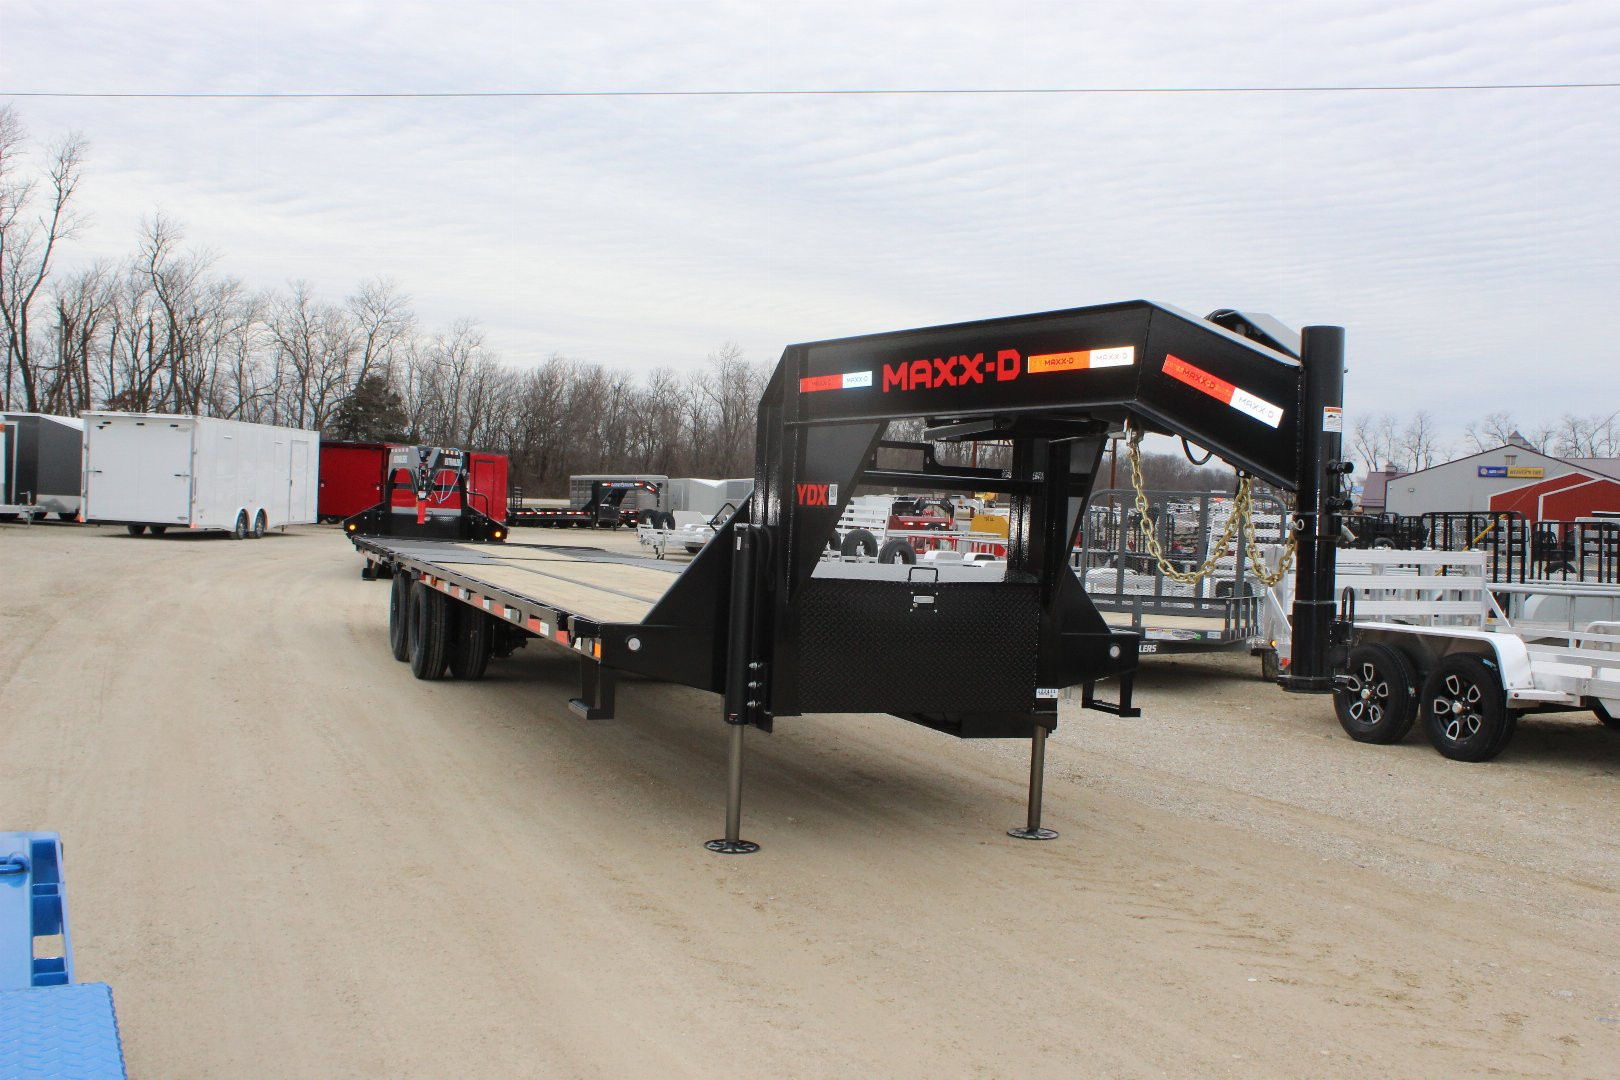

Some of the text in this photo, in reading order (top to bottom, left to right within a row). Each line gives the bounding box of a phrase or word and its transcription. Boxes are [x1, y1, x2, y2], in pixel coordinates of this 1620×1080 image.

[882, 348, 1021, 393] MAXX-D
[1044, 357, 1074, 366] MAXX-D
[1182, 367, 1216, 390] MAXX-D
[796, 483, 828, 506] YDX
[1138, 643, 1157, 653] LERS
